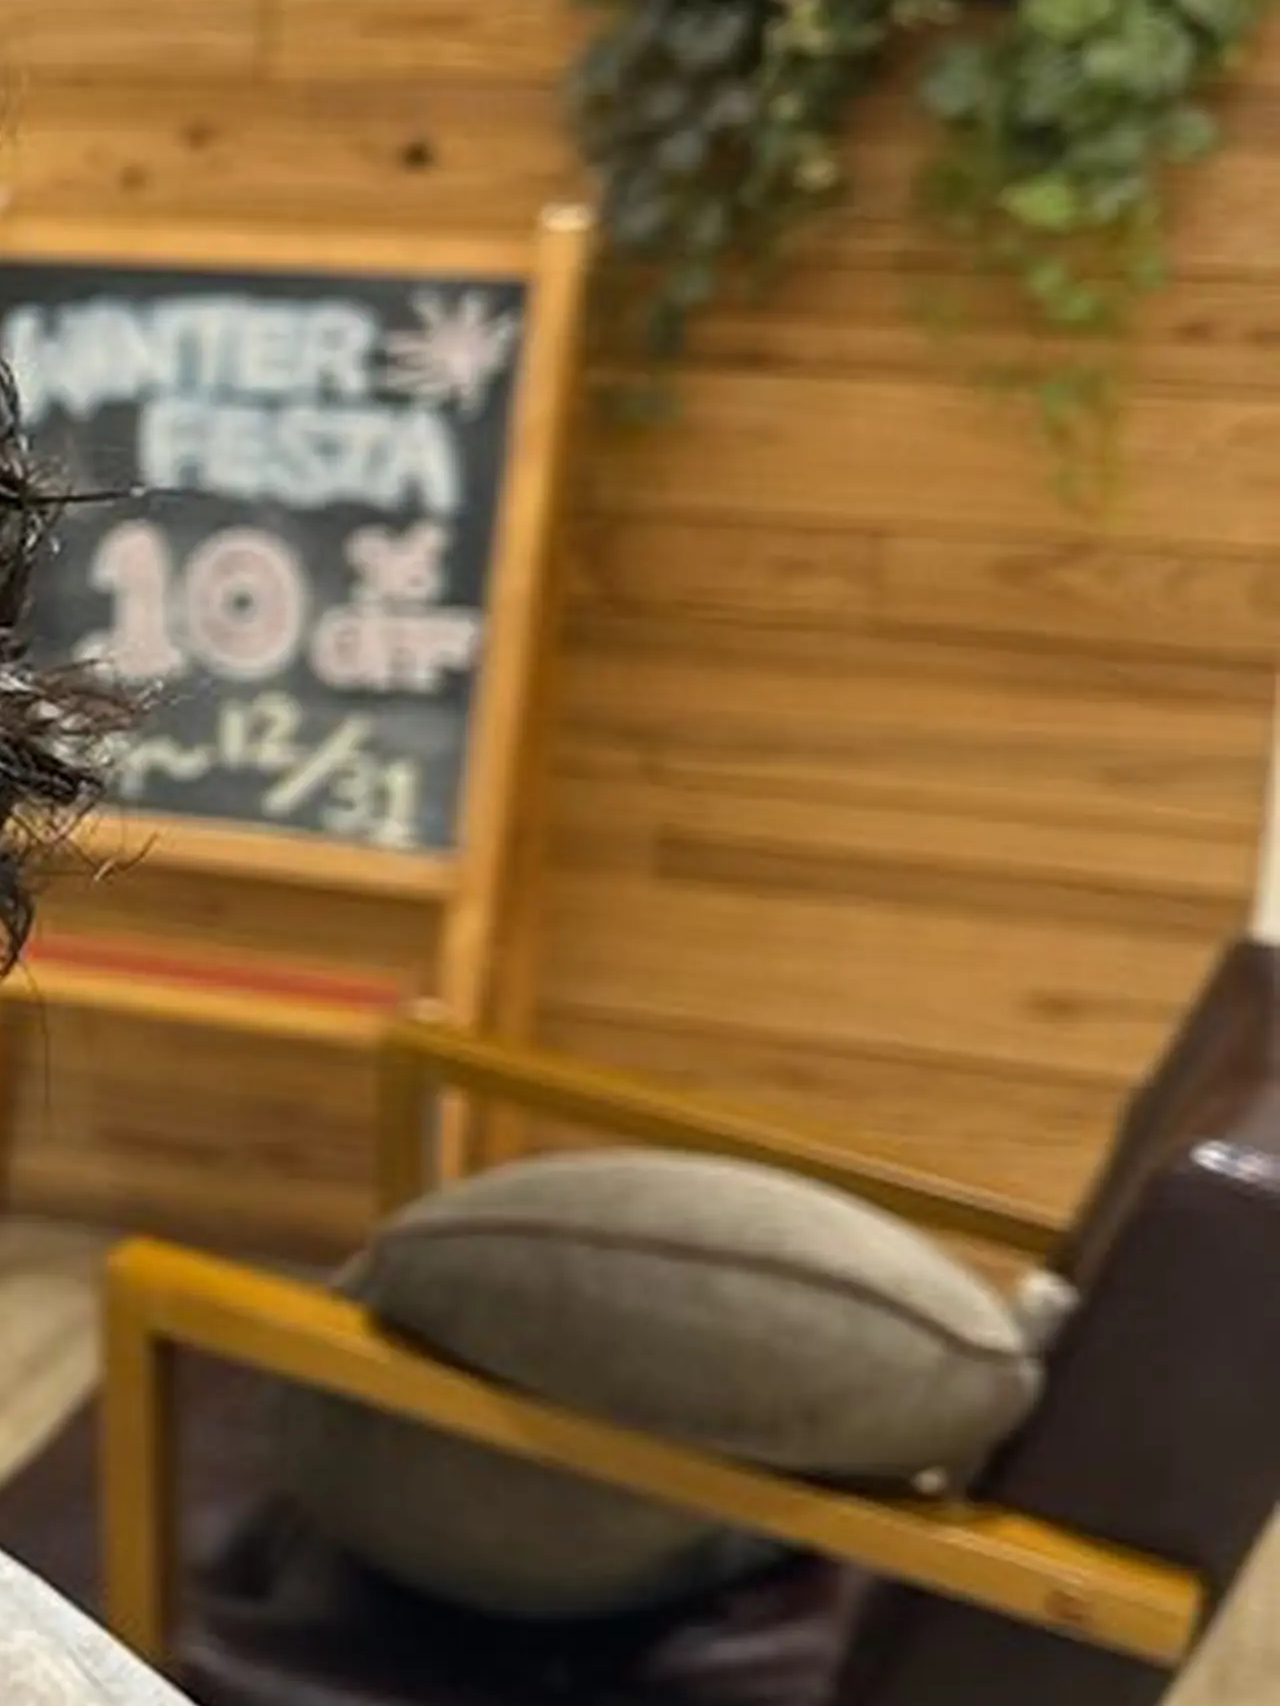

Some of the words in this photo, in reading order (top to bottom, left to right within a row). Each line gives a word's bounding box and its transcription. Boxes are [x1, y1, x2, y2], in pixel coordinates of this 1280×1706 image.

[2, 295, 378, 417] WINTER
[140, 398, 460, 515] FESTA
[72, 518, 306, 683] 10
